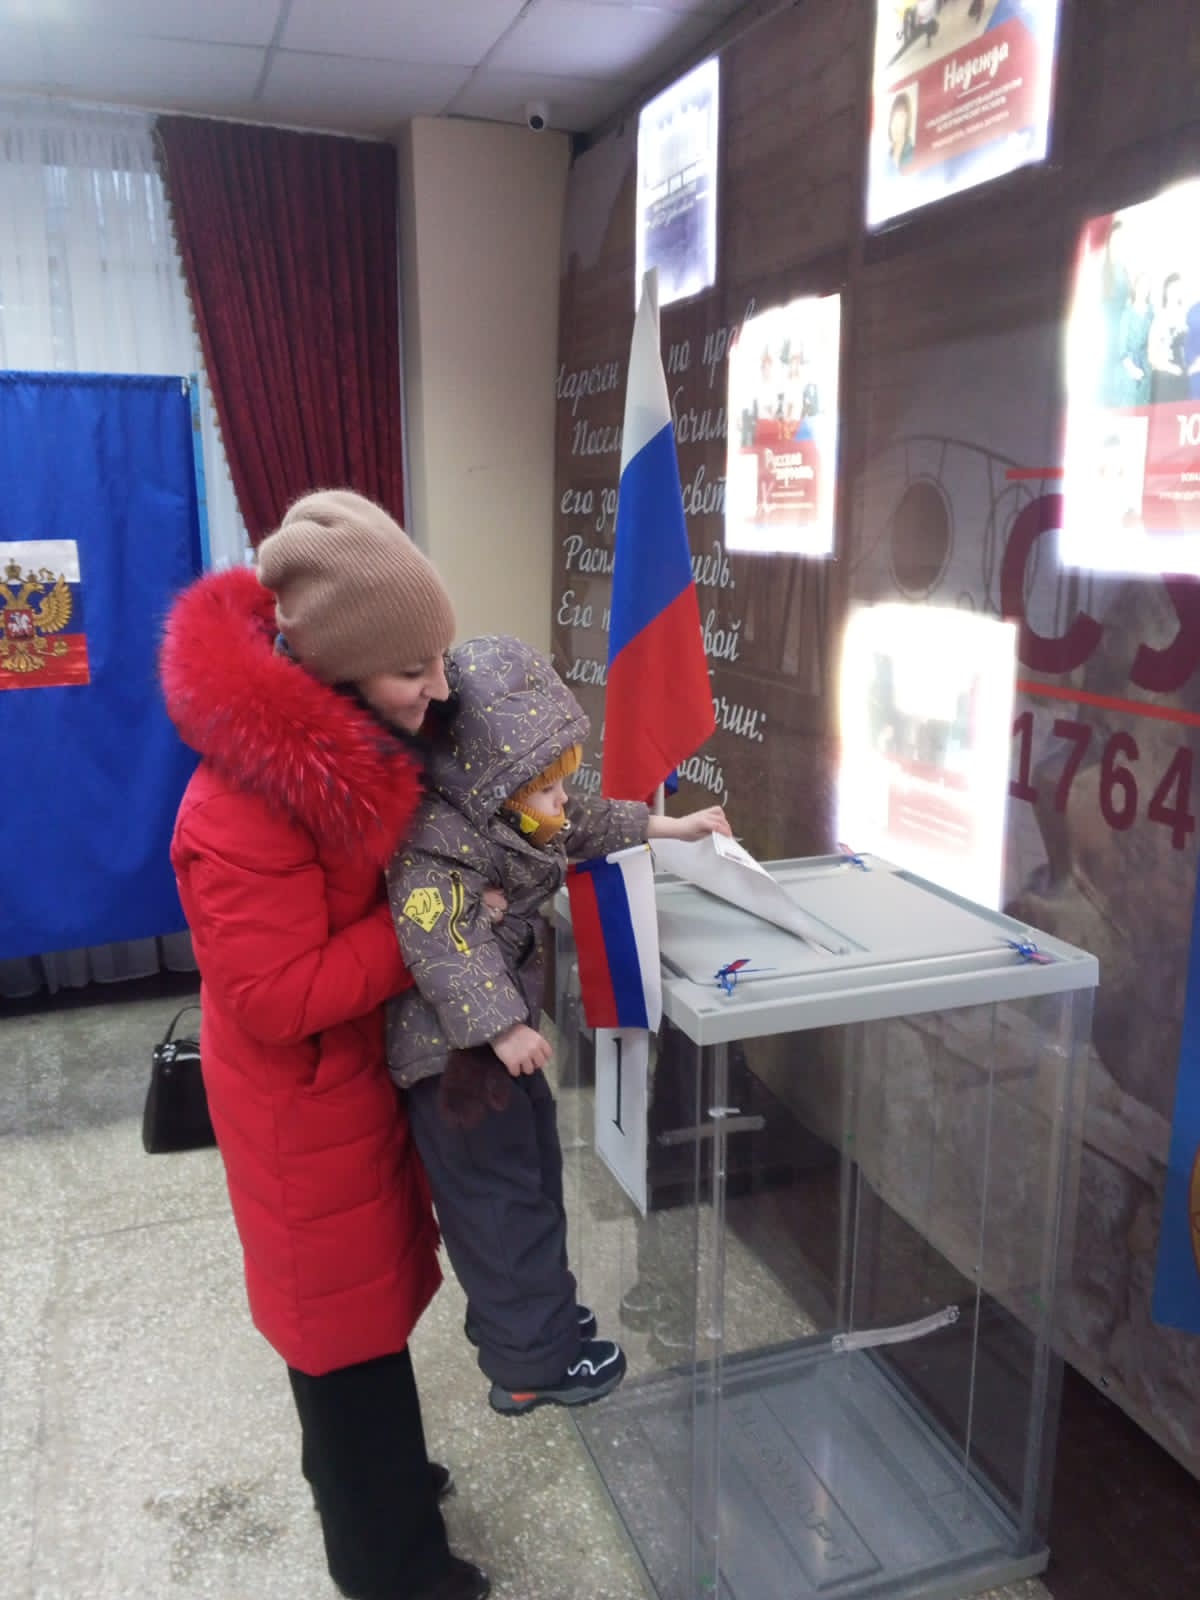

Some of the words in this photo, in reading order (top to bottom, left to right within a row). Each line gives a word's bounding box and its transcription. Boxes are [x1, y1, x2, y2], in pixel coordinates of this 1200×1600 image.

[571, 420, 622, 456] Посел
[671, 386, 728, 443] бочим
[560, 488, 593, 514] его
[681, 464, 727, 515] свет
[557, 590, 593, 628] Его
[700, 608, 741, 662] вой
[1008, 712, 1196, 850] 1764
